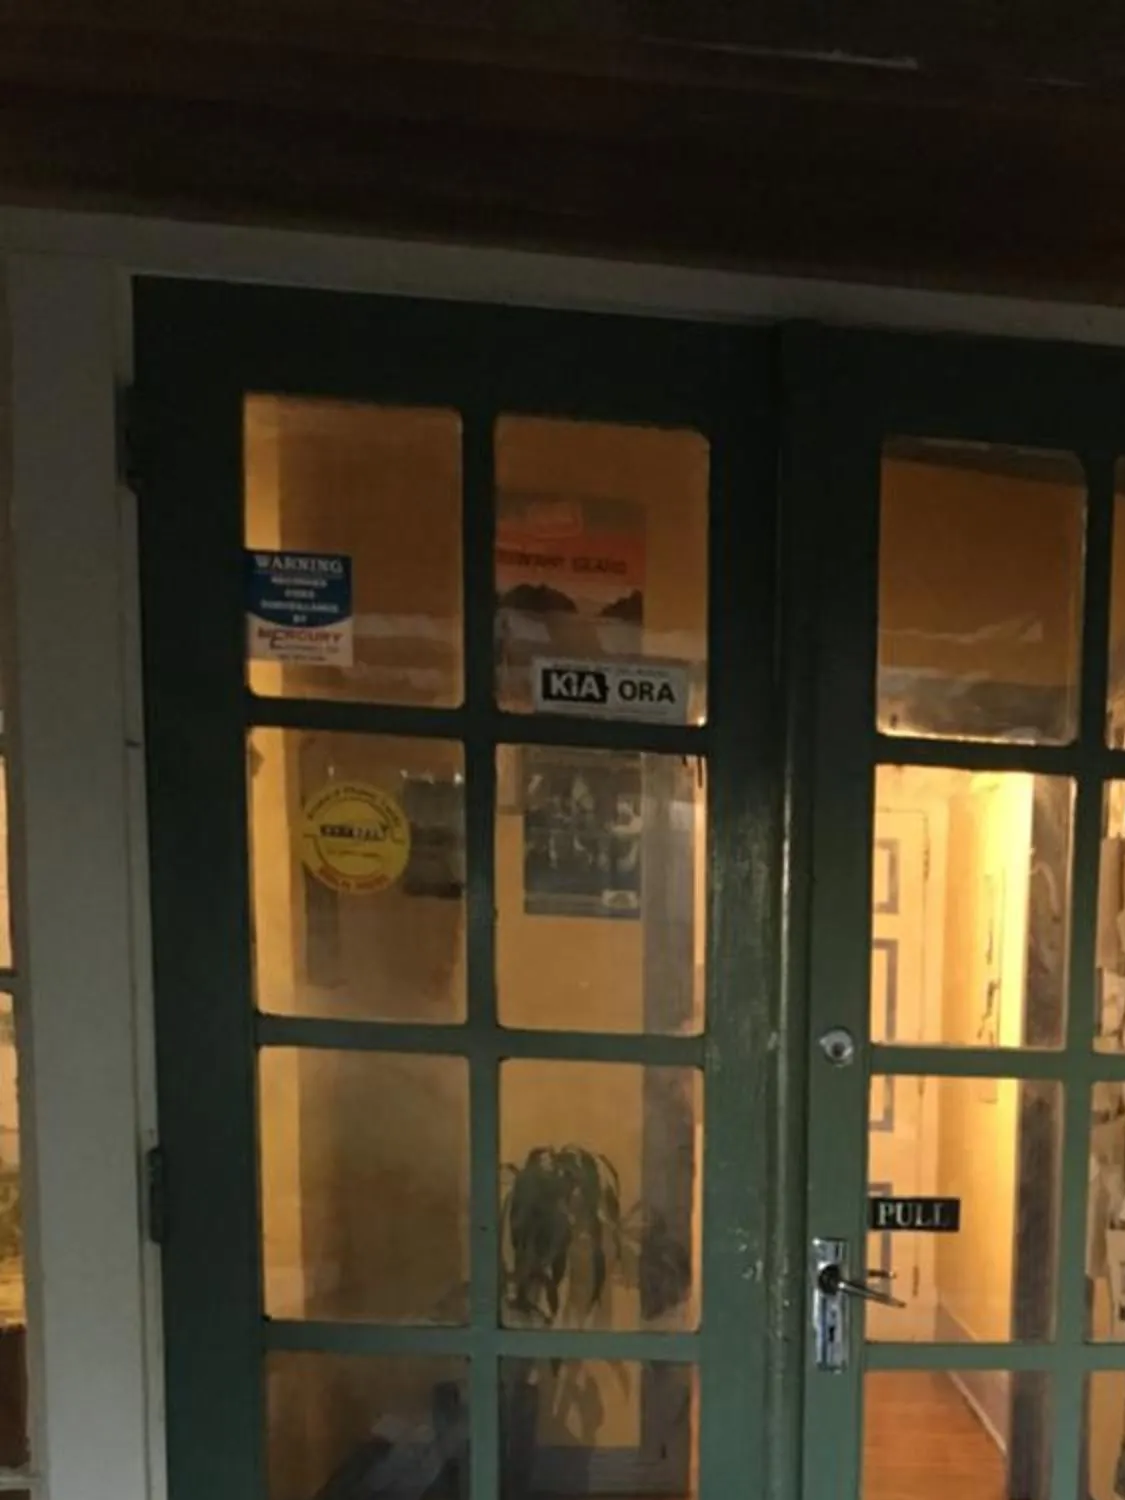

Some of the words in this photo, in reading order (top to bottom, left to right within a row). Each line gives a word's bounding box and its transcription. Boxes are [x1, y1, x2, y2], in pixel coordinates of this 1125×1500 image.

[254, 555, 344, 574] WARNING
[550, 672, 602, 699] KIA
[618, 679, 676, 704] ORA
[878, 1202, 947, 1226] PULL
